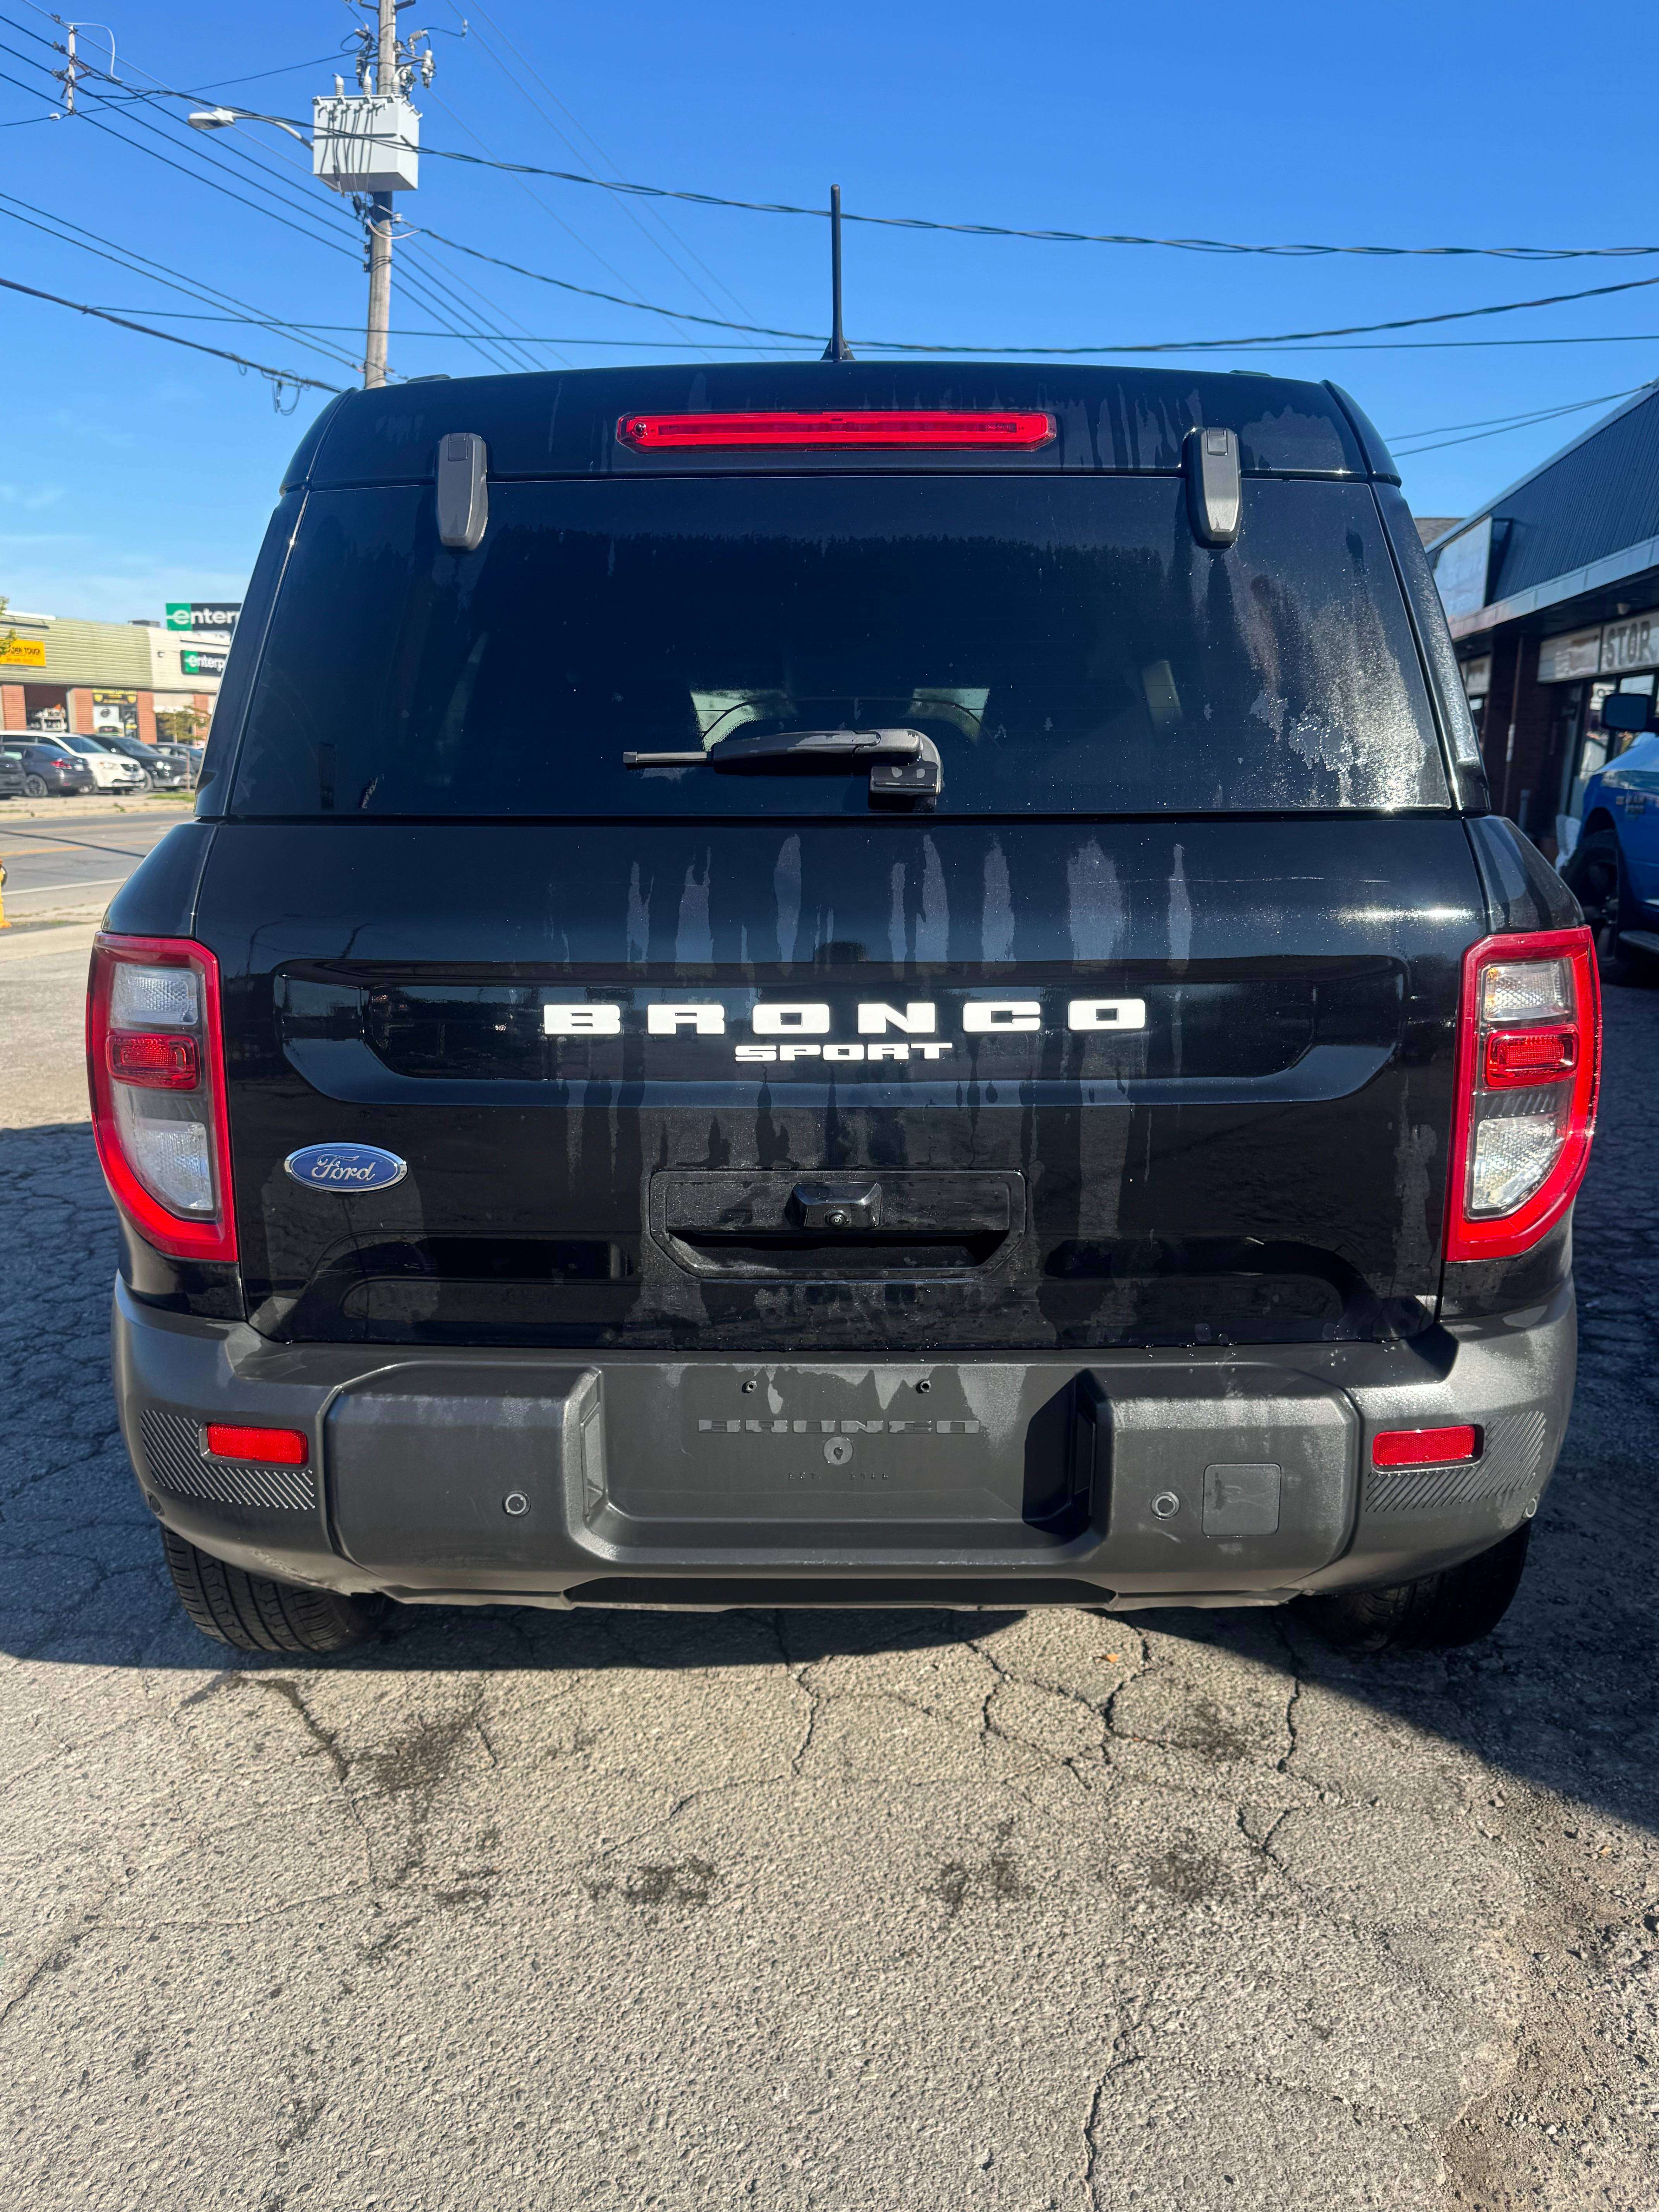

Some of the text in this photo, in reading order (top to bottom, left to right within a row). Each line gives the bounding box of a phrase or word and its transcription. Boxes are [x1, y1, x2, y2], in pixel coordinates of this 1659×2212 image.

[543, 998, 1146, 1034] BRONCO
[735, 1042, 953, 1061] SPORT
[312, 1154, 376, 1182] Ford
[698, 1420, 979, 1434] BRONCO
